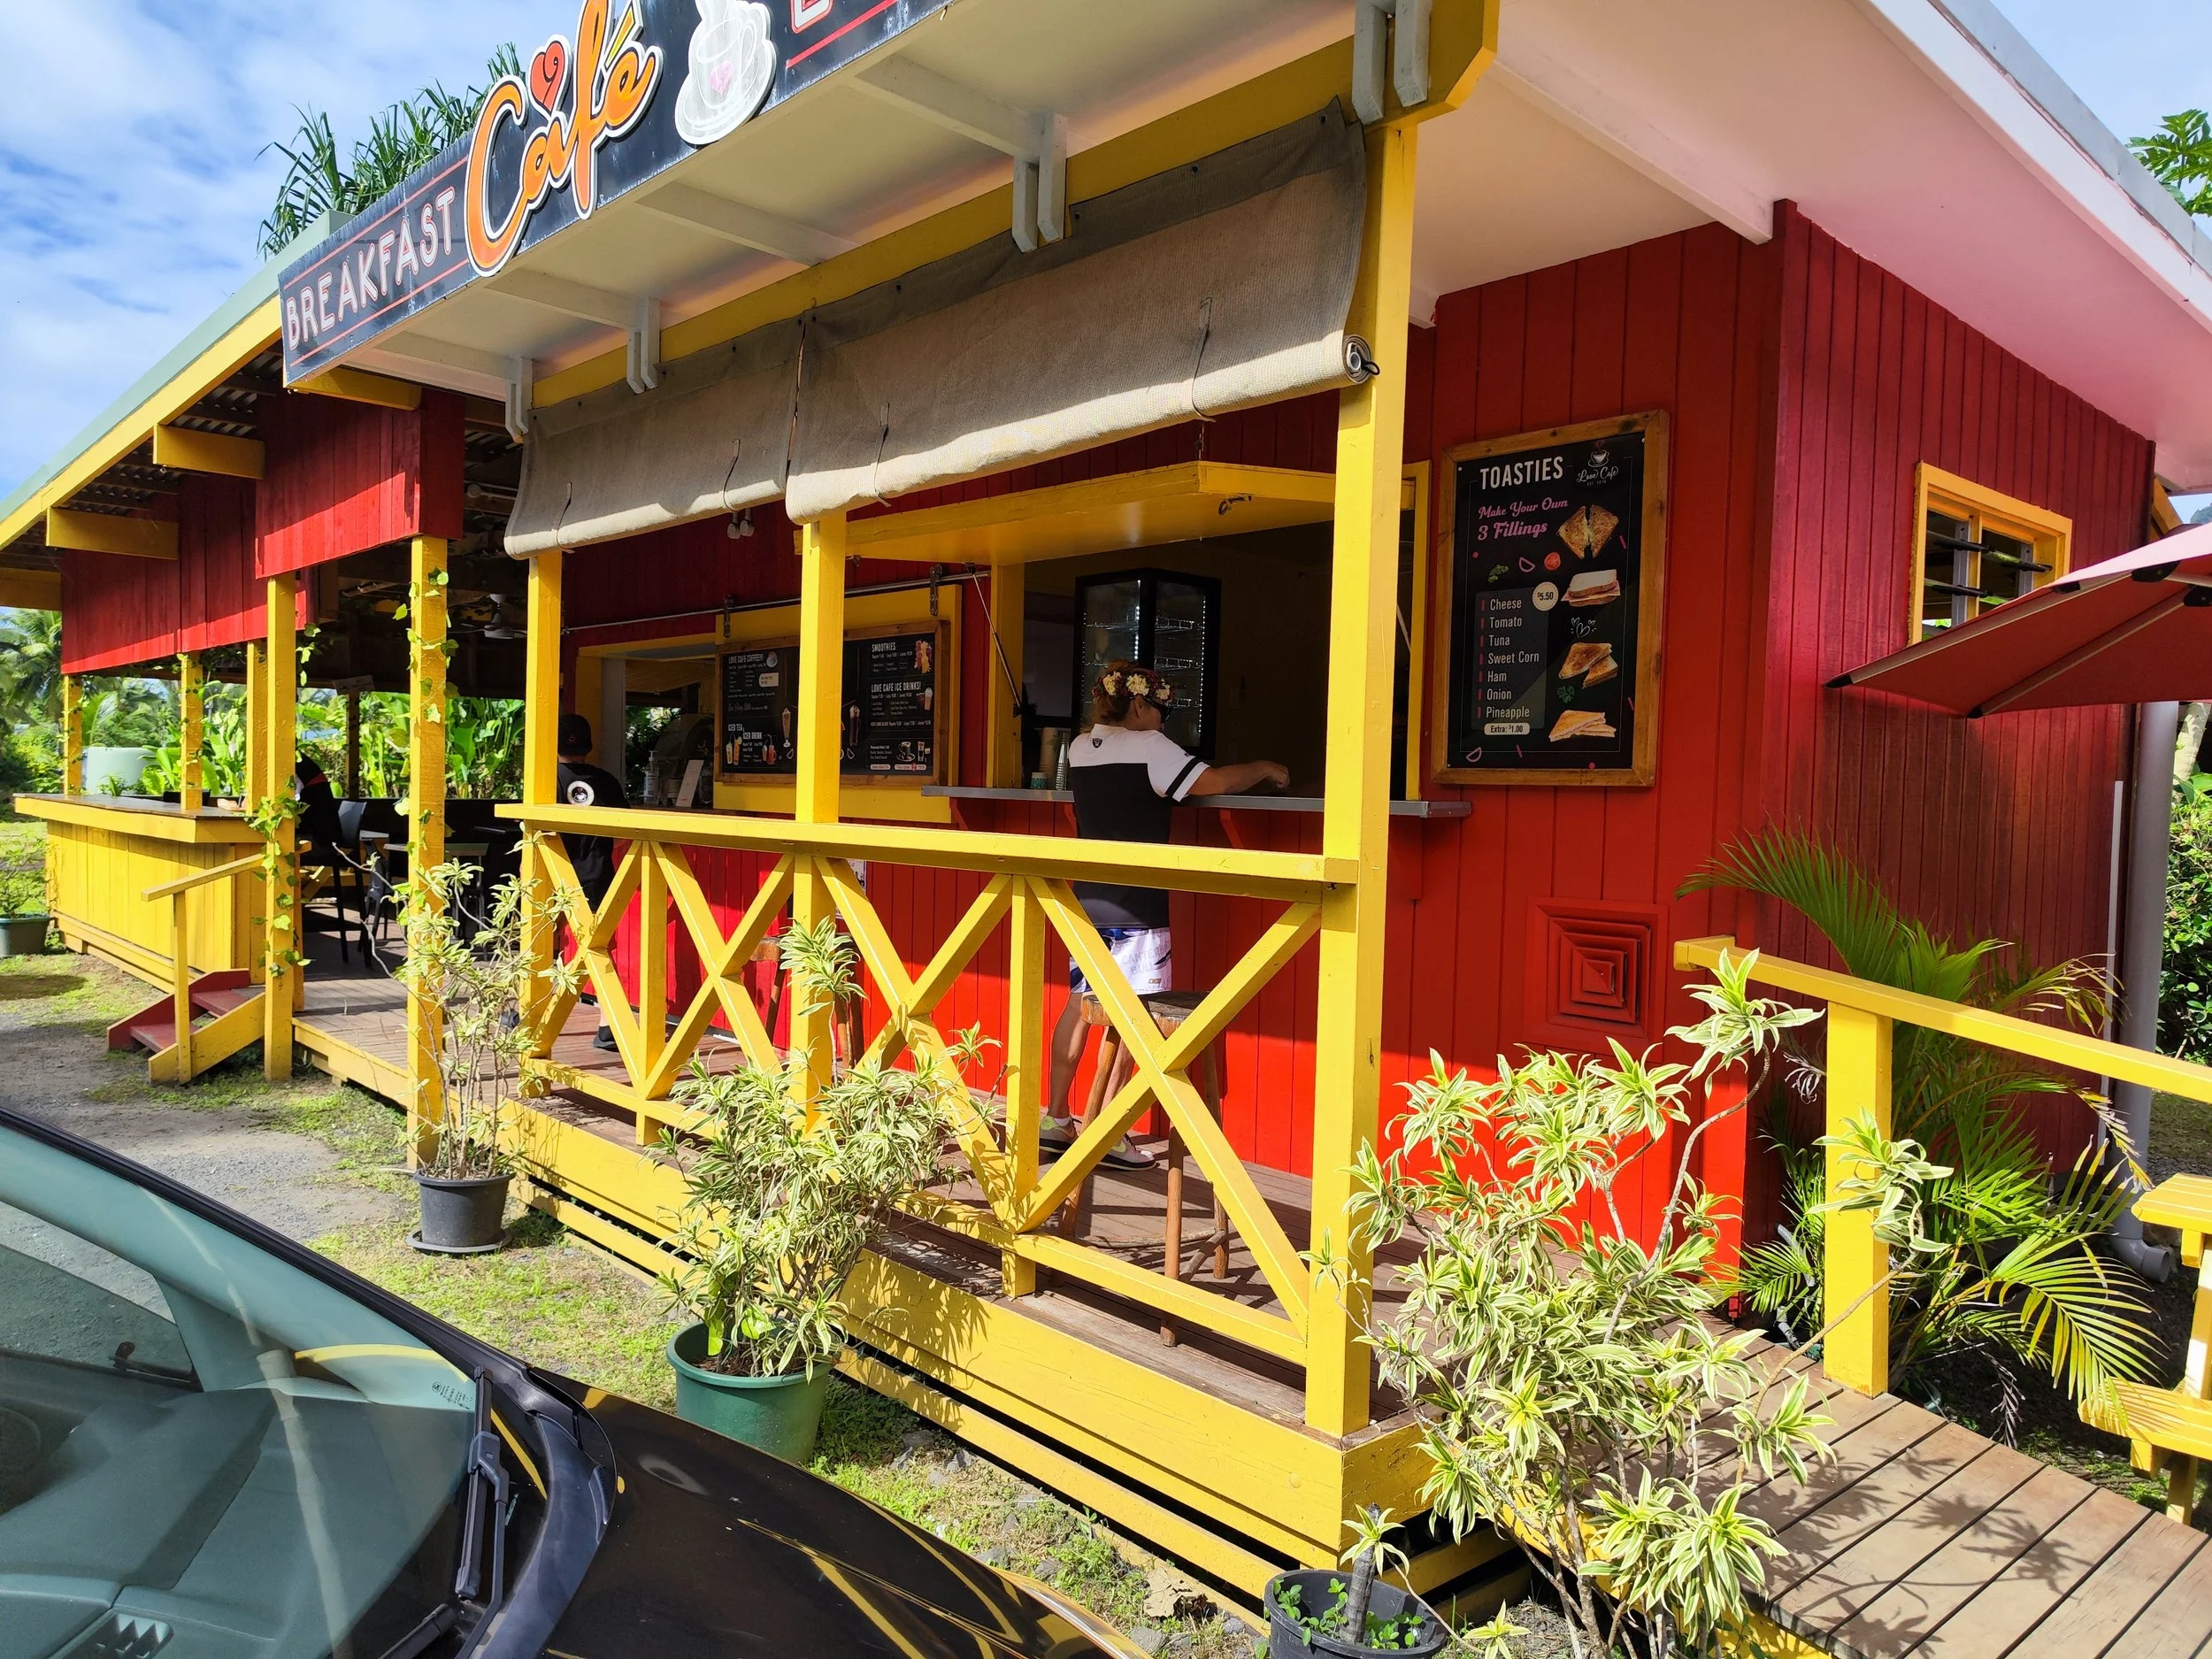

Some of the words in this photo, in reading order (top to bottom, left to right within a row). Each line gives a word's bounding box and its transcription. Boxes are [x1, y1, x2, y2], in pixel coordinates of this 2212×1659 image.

[285, 186, 457, 351] BREAKFAST
[1479, 455, 1563, 490] TOASTIES
[1576, 468, 1599, 483] Love
[1478, 504, 1507, 519] Make
[1509, 501, 1539, 517] Your
[1541, 496, 1570, 511] Own
[1478, 525, 1489, 541] 3
[1493, 520, 1548, 539] Fillings
[1537, 591, 1554, 601] $5.50
[1489, 598, 1522, 611] Cheese
[1489, 617, 1523, 629] Tomato
[872, 641, 896, 653] SMOOTHIES
[1488, 634, 1510, 647] Tuna
[1487, 652, 1515, 665] Sweet
[1518, 650, 1540, 664] Corn
[1486, 670, 1507, 683] Ham
[871, 683, 882, 693] LOVE
[883, 682, 895, 692] CAFE
[902, 680, 922, 691] DRINKS!
[1486, 687, 1512, 701] Onion
[1486, 705, 1530, 720] Pineapple
[1490, 725, 1508, 733] Extra:
[1509, 725, 1524, 733] $1.00
